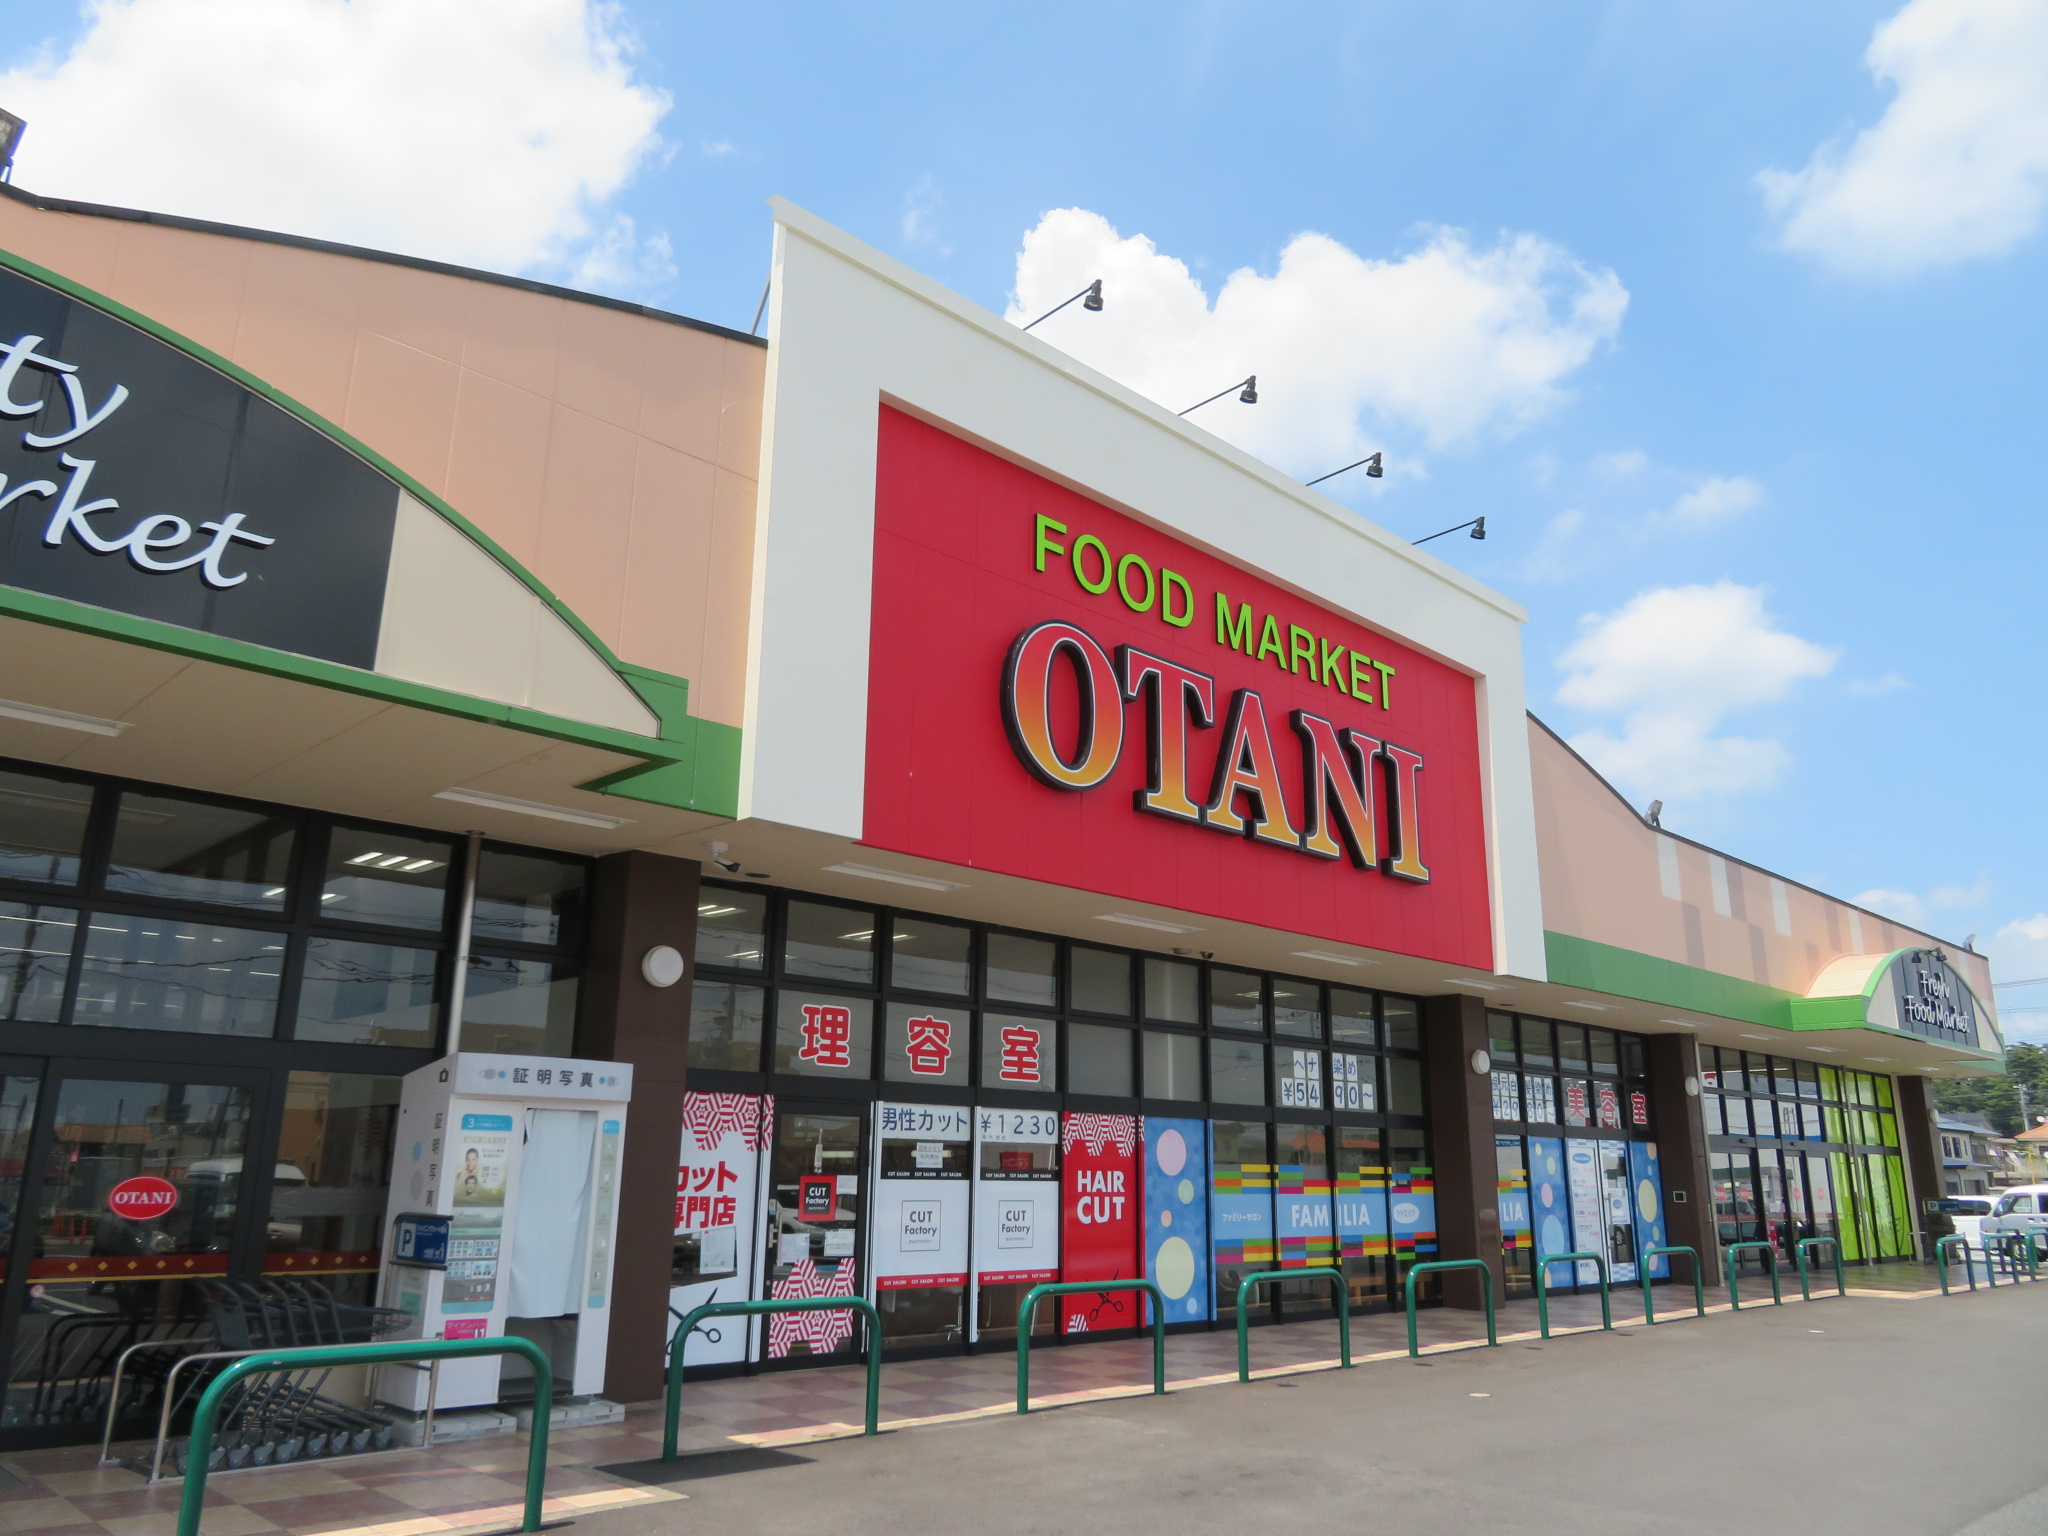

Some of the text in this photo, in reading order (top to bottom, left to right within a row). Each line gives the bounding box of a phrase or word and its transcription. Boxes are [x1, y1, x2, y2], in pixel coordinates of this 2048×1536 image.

[0, 334, 130, 448] ty
[1035, 513, 1396, 710] FOOD MARKET
[1000, 619, 1431, 884] OTANI
[799, 1004, 1040, 1082] 理容室
[513, 1068, 593, 1087] 証明写真
[1567, 1084, 1647, 1125] 美容室
[882, 1107, 968, 1133] 男性カット
[981, 1113, 1056, 1135] ¥1230
[1077, 1170, 1125, 1192] HAIR
[115, 1192, 172, 1204] OTANI
[805, 1197, 829, 1206] Factory
[809, 1187, 826, 1196] CUT
[909, 1211, 933, 1223] CUT
[1005, 1210, 1026, 1221] CUT
[1077, 1196, 1125, 1224] CUT
[1222, 1213, 1262, 1222] ファミリーサロン
[1291, 1203, 1370, 1227] FAMILIA
[1503, 1202, 1524, 1221] LIA
[904, 1225, 937, 1237] Factory
[1001, 1224, 1030, 1235] Factory
